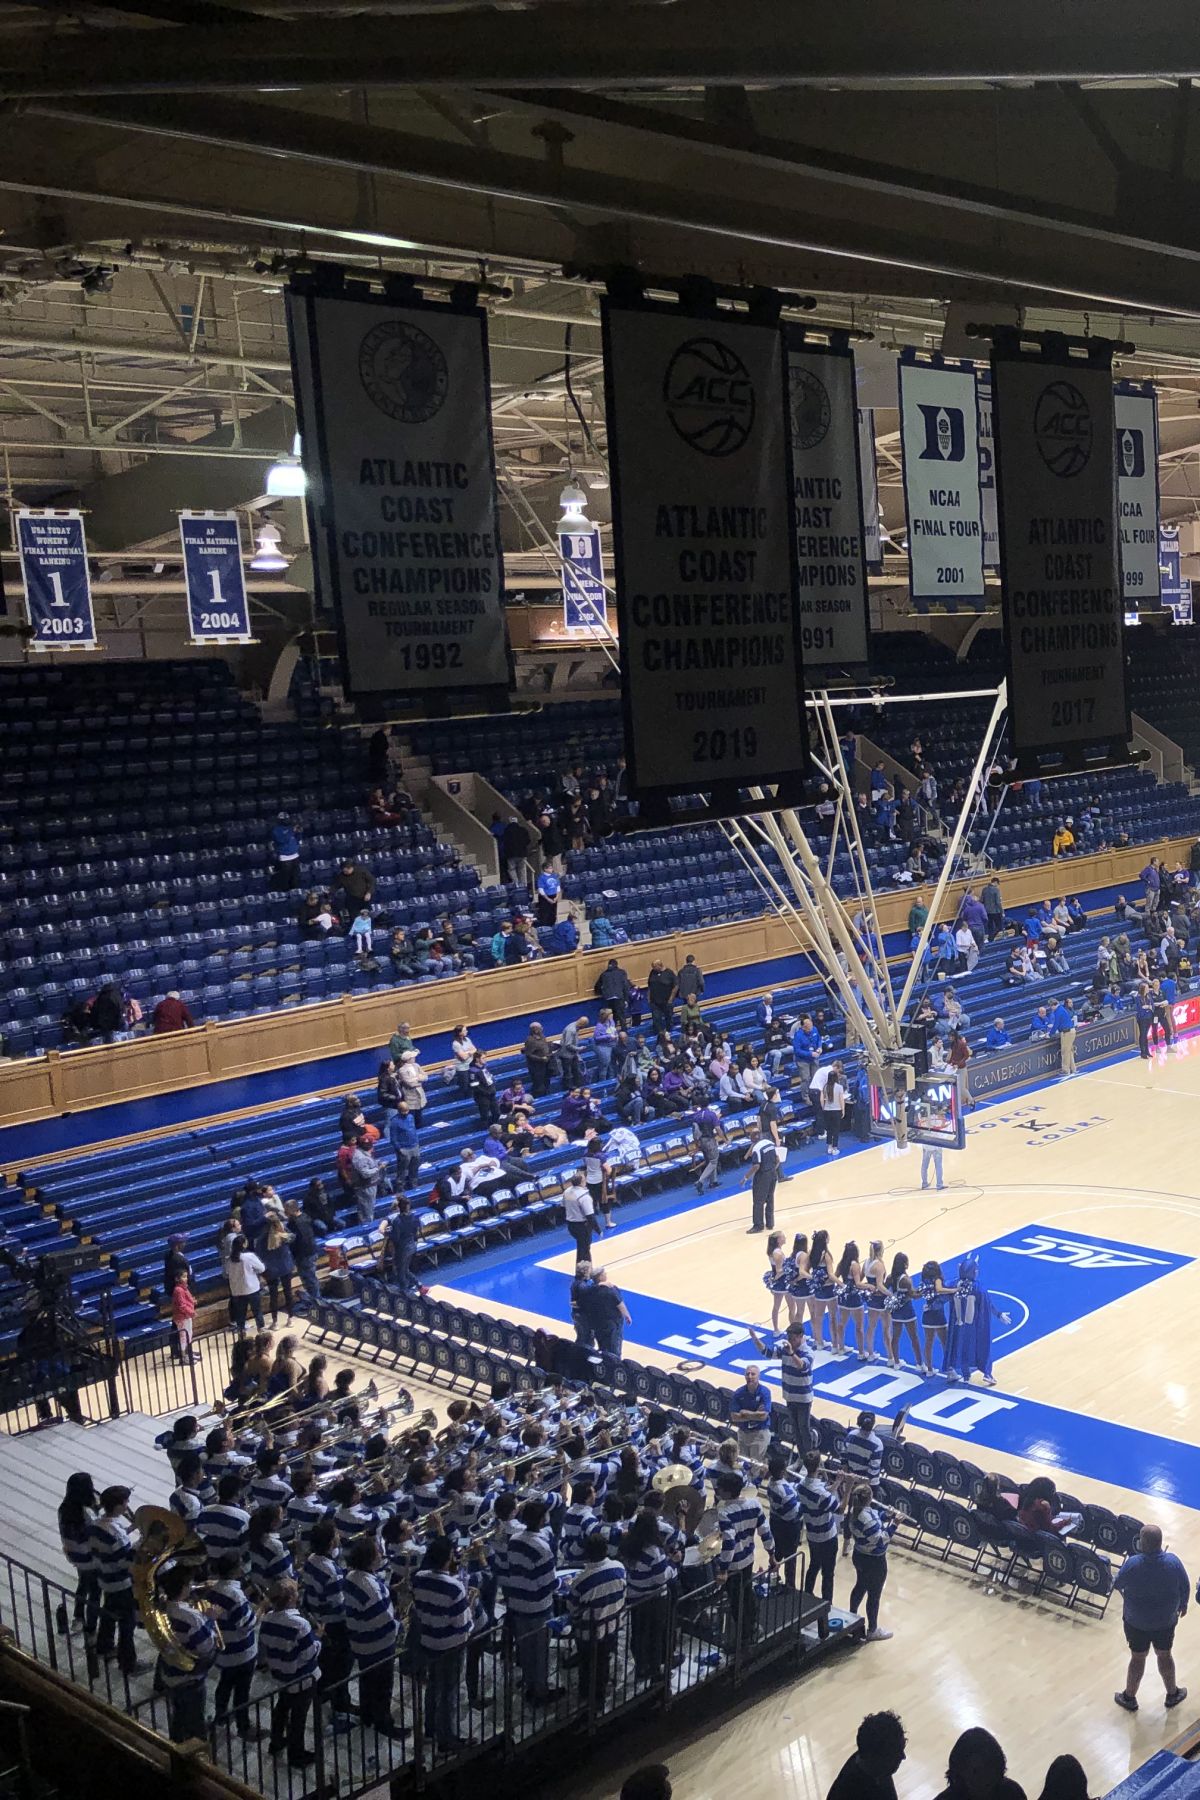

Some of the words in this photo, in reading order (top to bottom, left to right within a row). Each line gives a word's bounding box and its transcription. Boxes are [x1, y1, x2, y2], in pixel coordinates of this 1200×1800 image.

[675, 376, 753, 406] ACC
[360, 459, 468, 489] ATLANTIC
[381, 496, 454, 523] COAST
[929, 490, 961, 507] NCAA
[31, 526, 46, 535] USA
[47, 526, 71, 535] TODAY
[206, 528, 216, 536] AP
[655, 504, 767, 539] ATLANTIC
[913, 519, 946, 536] FINAL
[950, 519, 980, 537] FOUR
[1028, 518, 1105, 546] ATLANTIC
[36, 536, 69, 545] WOMEN'S
[185, 537, 206, 545] FINAL
[206, 537, 238, 546] NATIONAL
[342, 531, 495, 559] CONFERENCE
[1133, 530, 1156, 544] FOUR
[23, 547, 46, 555] FINAL
[47, 547, 83, 555] NATIONAL
[39, 557, 71, 566] RANKING
[198, 547, 228, 555] RANKING
[679, 549, 757, 583] COAST
[936, 567, 964, 584] 2001
[1044, 553, 1093, 581] COAST
[47, 571, 70, 607] 1
[207, 569, 227, 603] 1
[353, 567, 492, 594] CHAMPIONS
[368, 600, 432, 616] REGULAR
[437, 600, 486, 615] SEASON
[632, 592, 789, 628] CONFERENCE
[815, 599, 851, 613] SEASON
[40, 618, 84, 635] 2003
[200, 613, 240, 628] 2004
[384, 620, 474, 637] TOURNAMENT
[1020, 623, 1118, 653] CHAMPIONS
[400, 643, 464, 671] 1992
[642, 634, 785, 671] CHAMPIONS
[1040, 665, 1106, 686] TOURNAMENT
[675, 686, 767, 711] TOURNAMENT
[1051, 698, 1097, 727] 2017
[693, 726, 758, 762] 2019
[974, 1057, 1033, 1089] CAMERON
[1084, 1027, 1130, 1053] STADIUM
[965, 1105, 1047, 1135] COACH
[1012, 1118, 1064, 1133] K
[1026, 1115, 1107, 1147] COURT
[991, 1237, 1154, 1269] ACC
